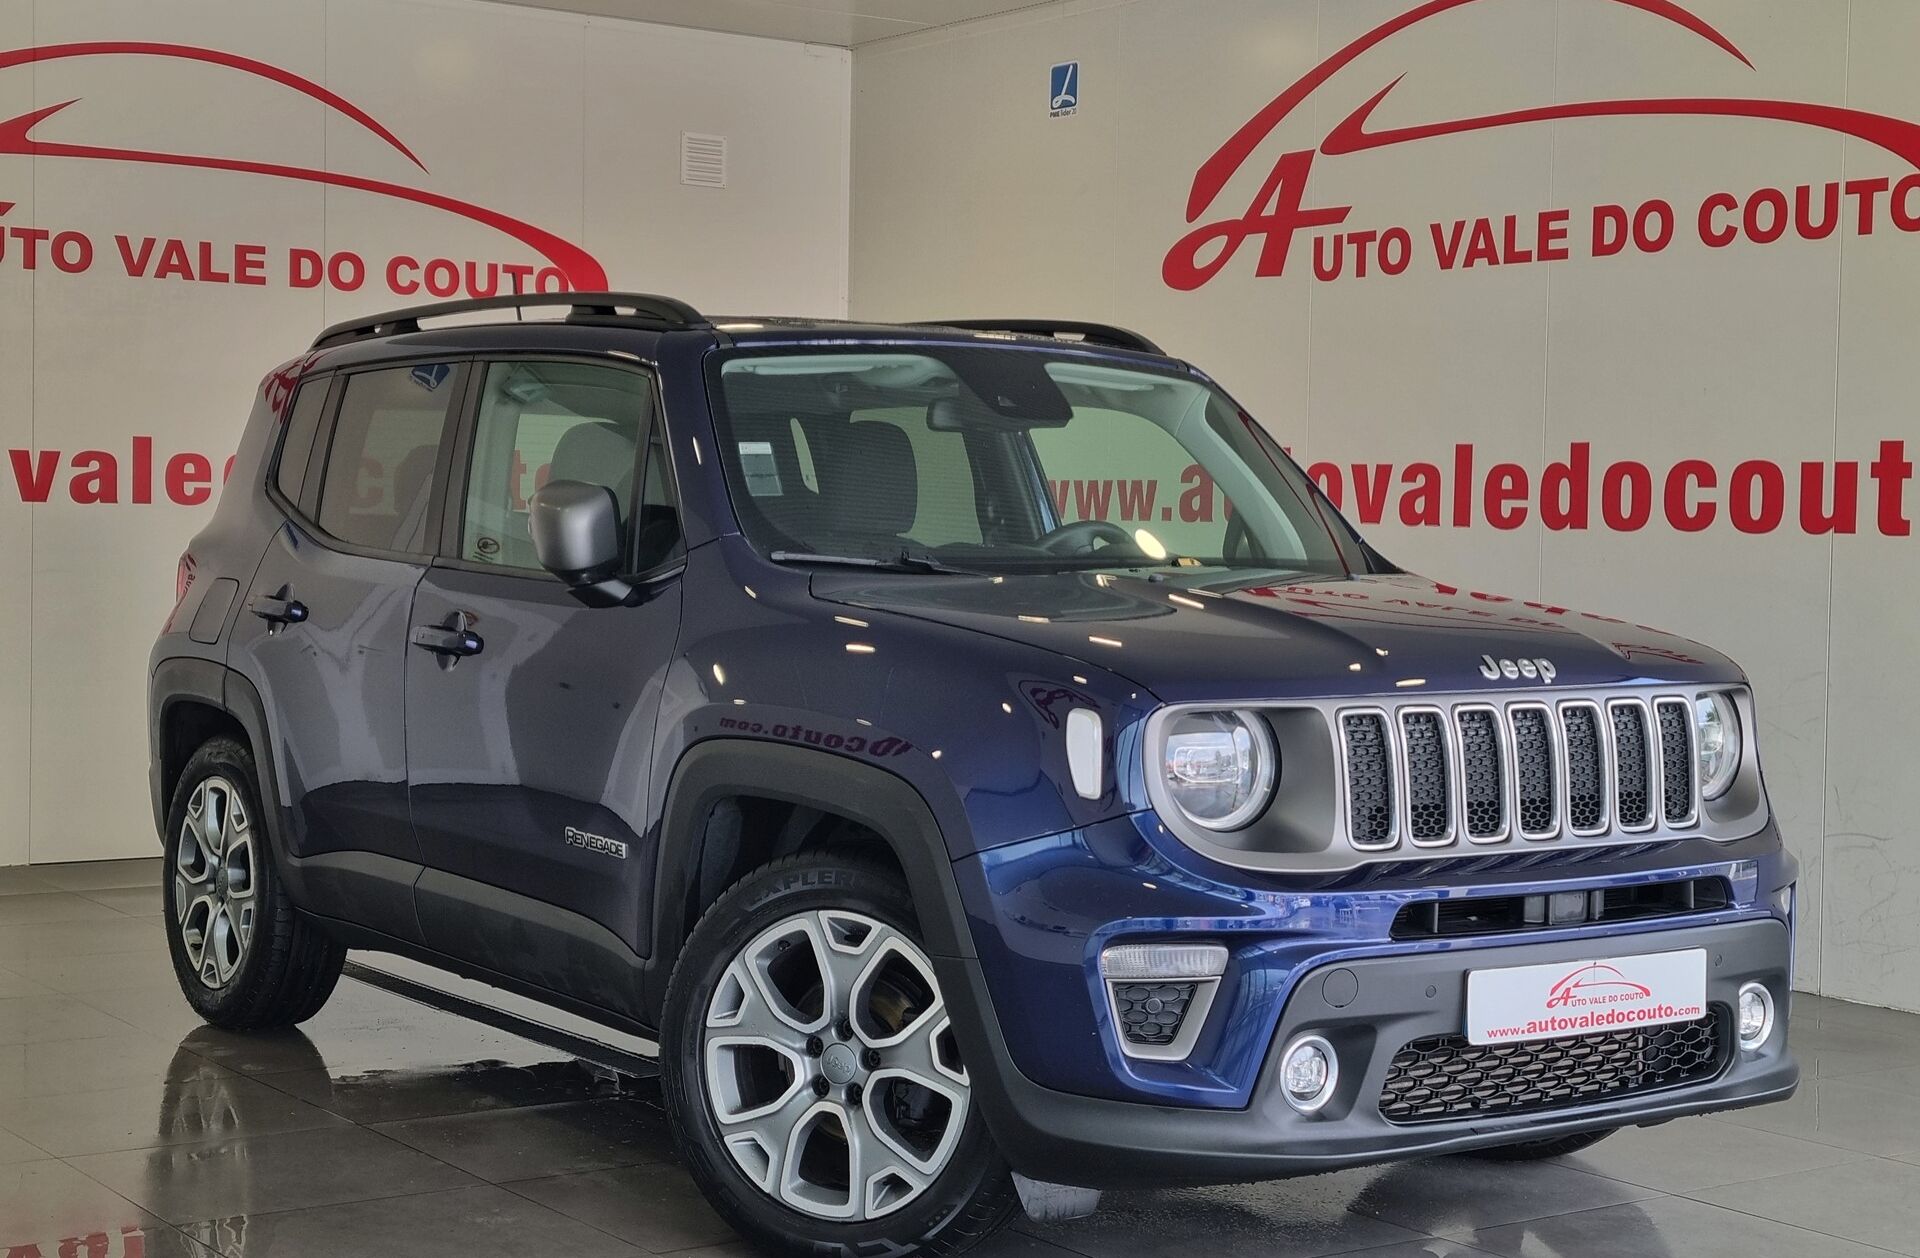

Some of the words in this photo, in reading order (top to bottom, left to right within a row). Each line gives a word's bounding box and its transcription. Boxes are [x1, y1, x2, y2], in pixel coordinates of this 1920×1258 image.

[1161, 149, 1413, 292] AUTO
[1429, 209, 1570, 270] VALE
[1591, 199, 1675, 257] DO
[1697, 173, 1920, 248] COUTO
[0, 201, 93, 274] TO
[114, 235, 267, 286] VALE
[289, 247, 366, 292] DO
[385, 255, 570, 300] COUTO
[1479, 654, 1556, 684] Jeep
[564, 826, 628, 859] RENEGADE
[1589, 995, 1606, 1005] VALE
[1608, 993, 1619, 1003] DO
[1619, 991, 1644, 1003] COUTO
[1487, 1003, 1701, 1039] www.autovaledocouto.com
